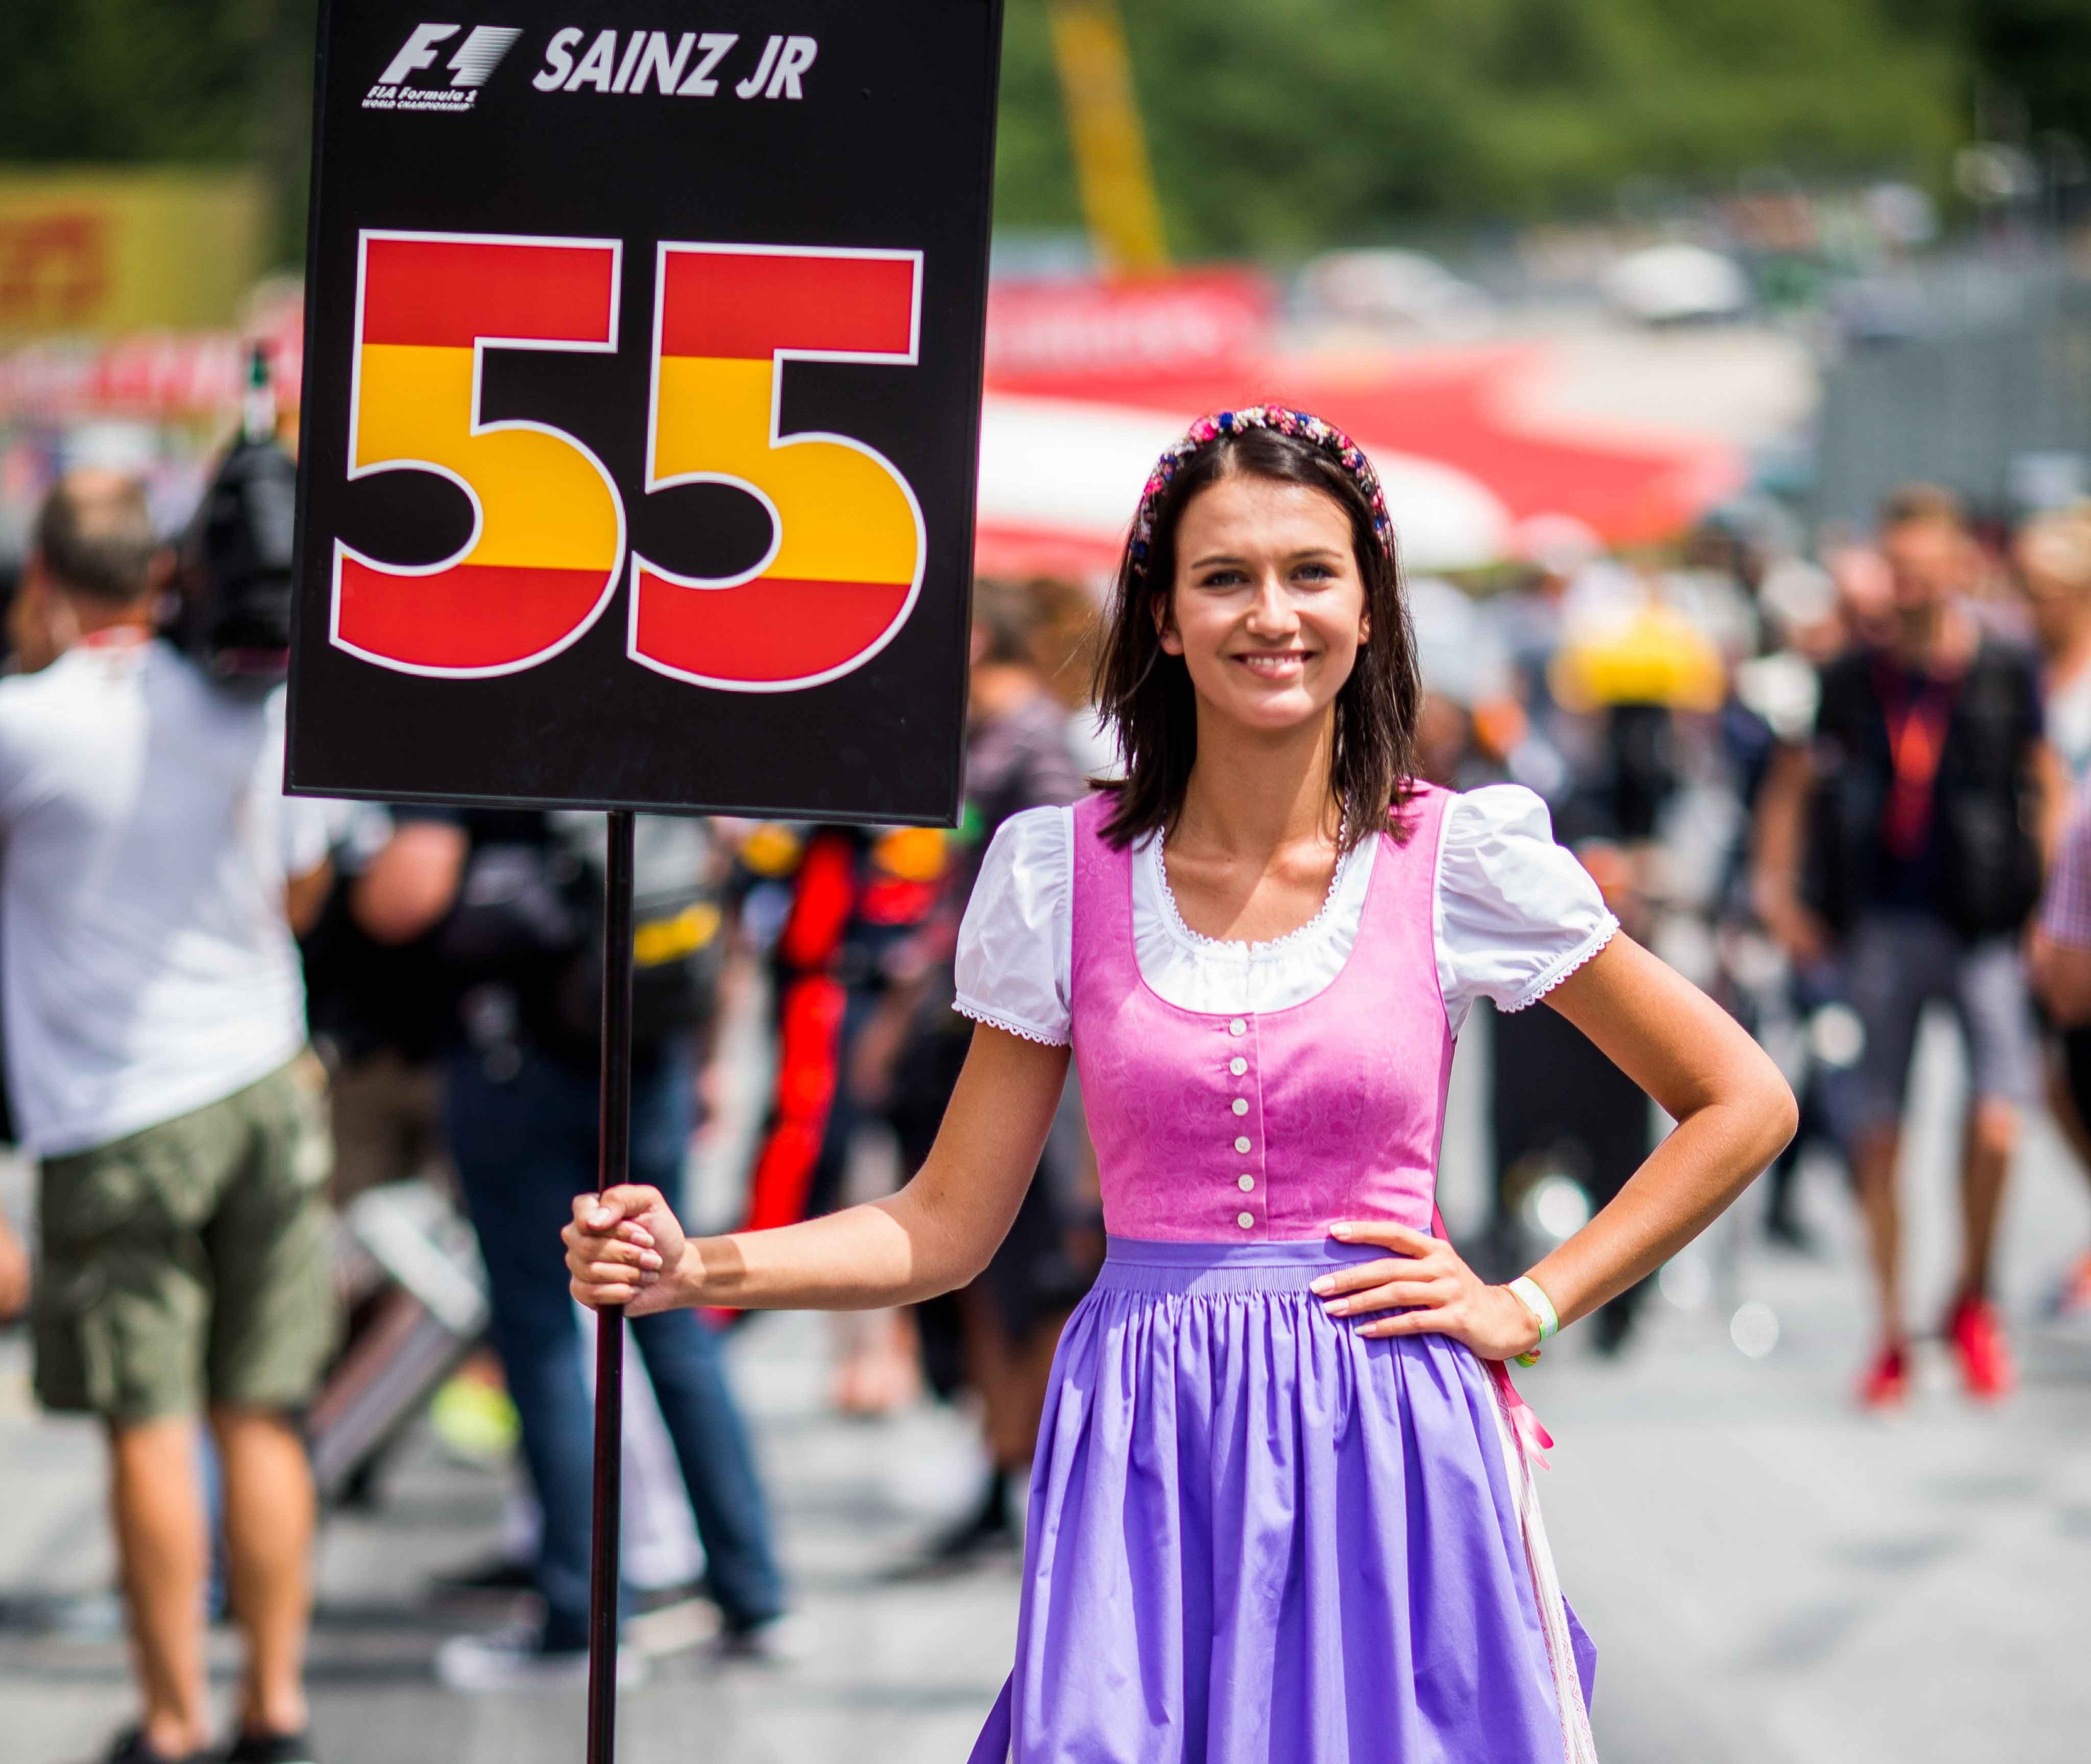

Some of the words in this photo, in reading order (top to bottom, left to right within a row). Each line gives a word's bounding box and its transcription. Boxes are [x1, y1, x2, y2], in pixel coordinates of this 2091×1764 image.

[378, 23, 524, 87] F1
[532, 28, 739, 96] SAINZ
[736, 35, 818, 99] JR
[361, 99, 397, 109] WORLD
[397, 100, 471, 111] CHAMPIONSHIP
[367, 85, 398, 99] FIA
[398, 86, 465, 102] Formula
[465, 89, 477, 103] 1
[328, 228, 928, 693] 55
